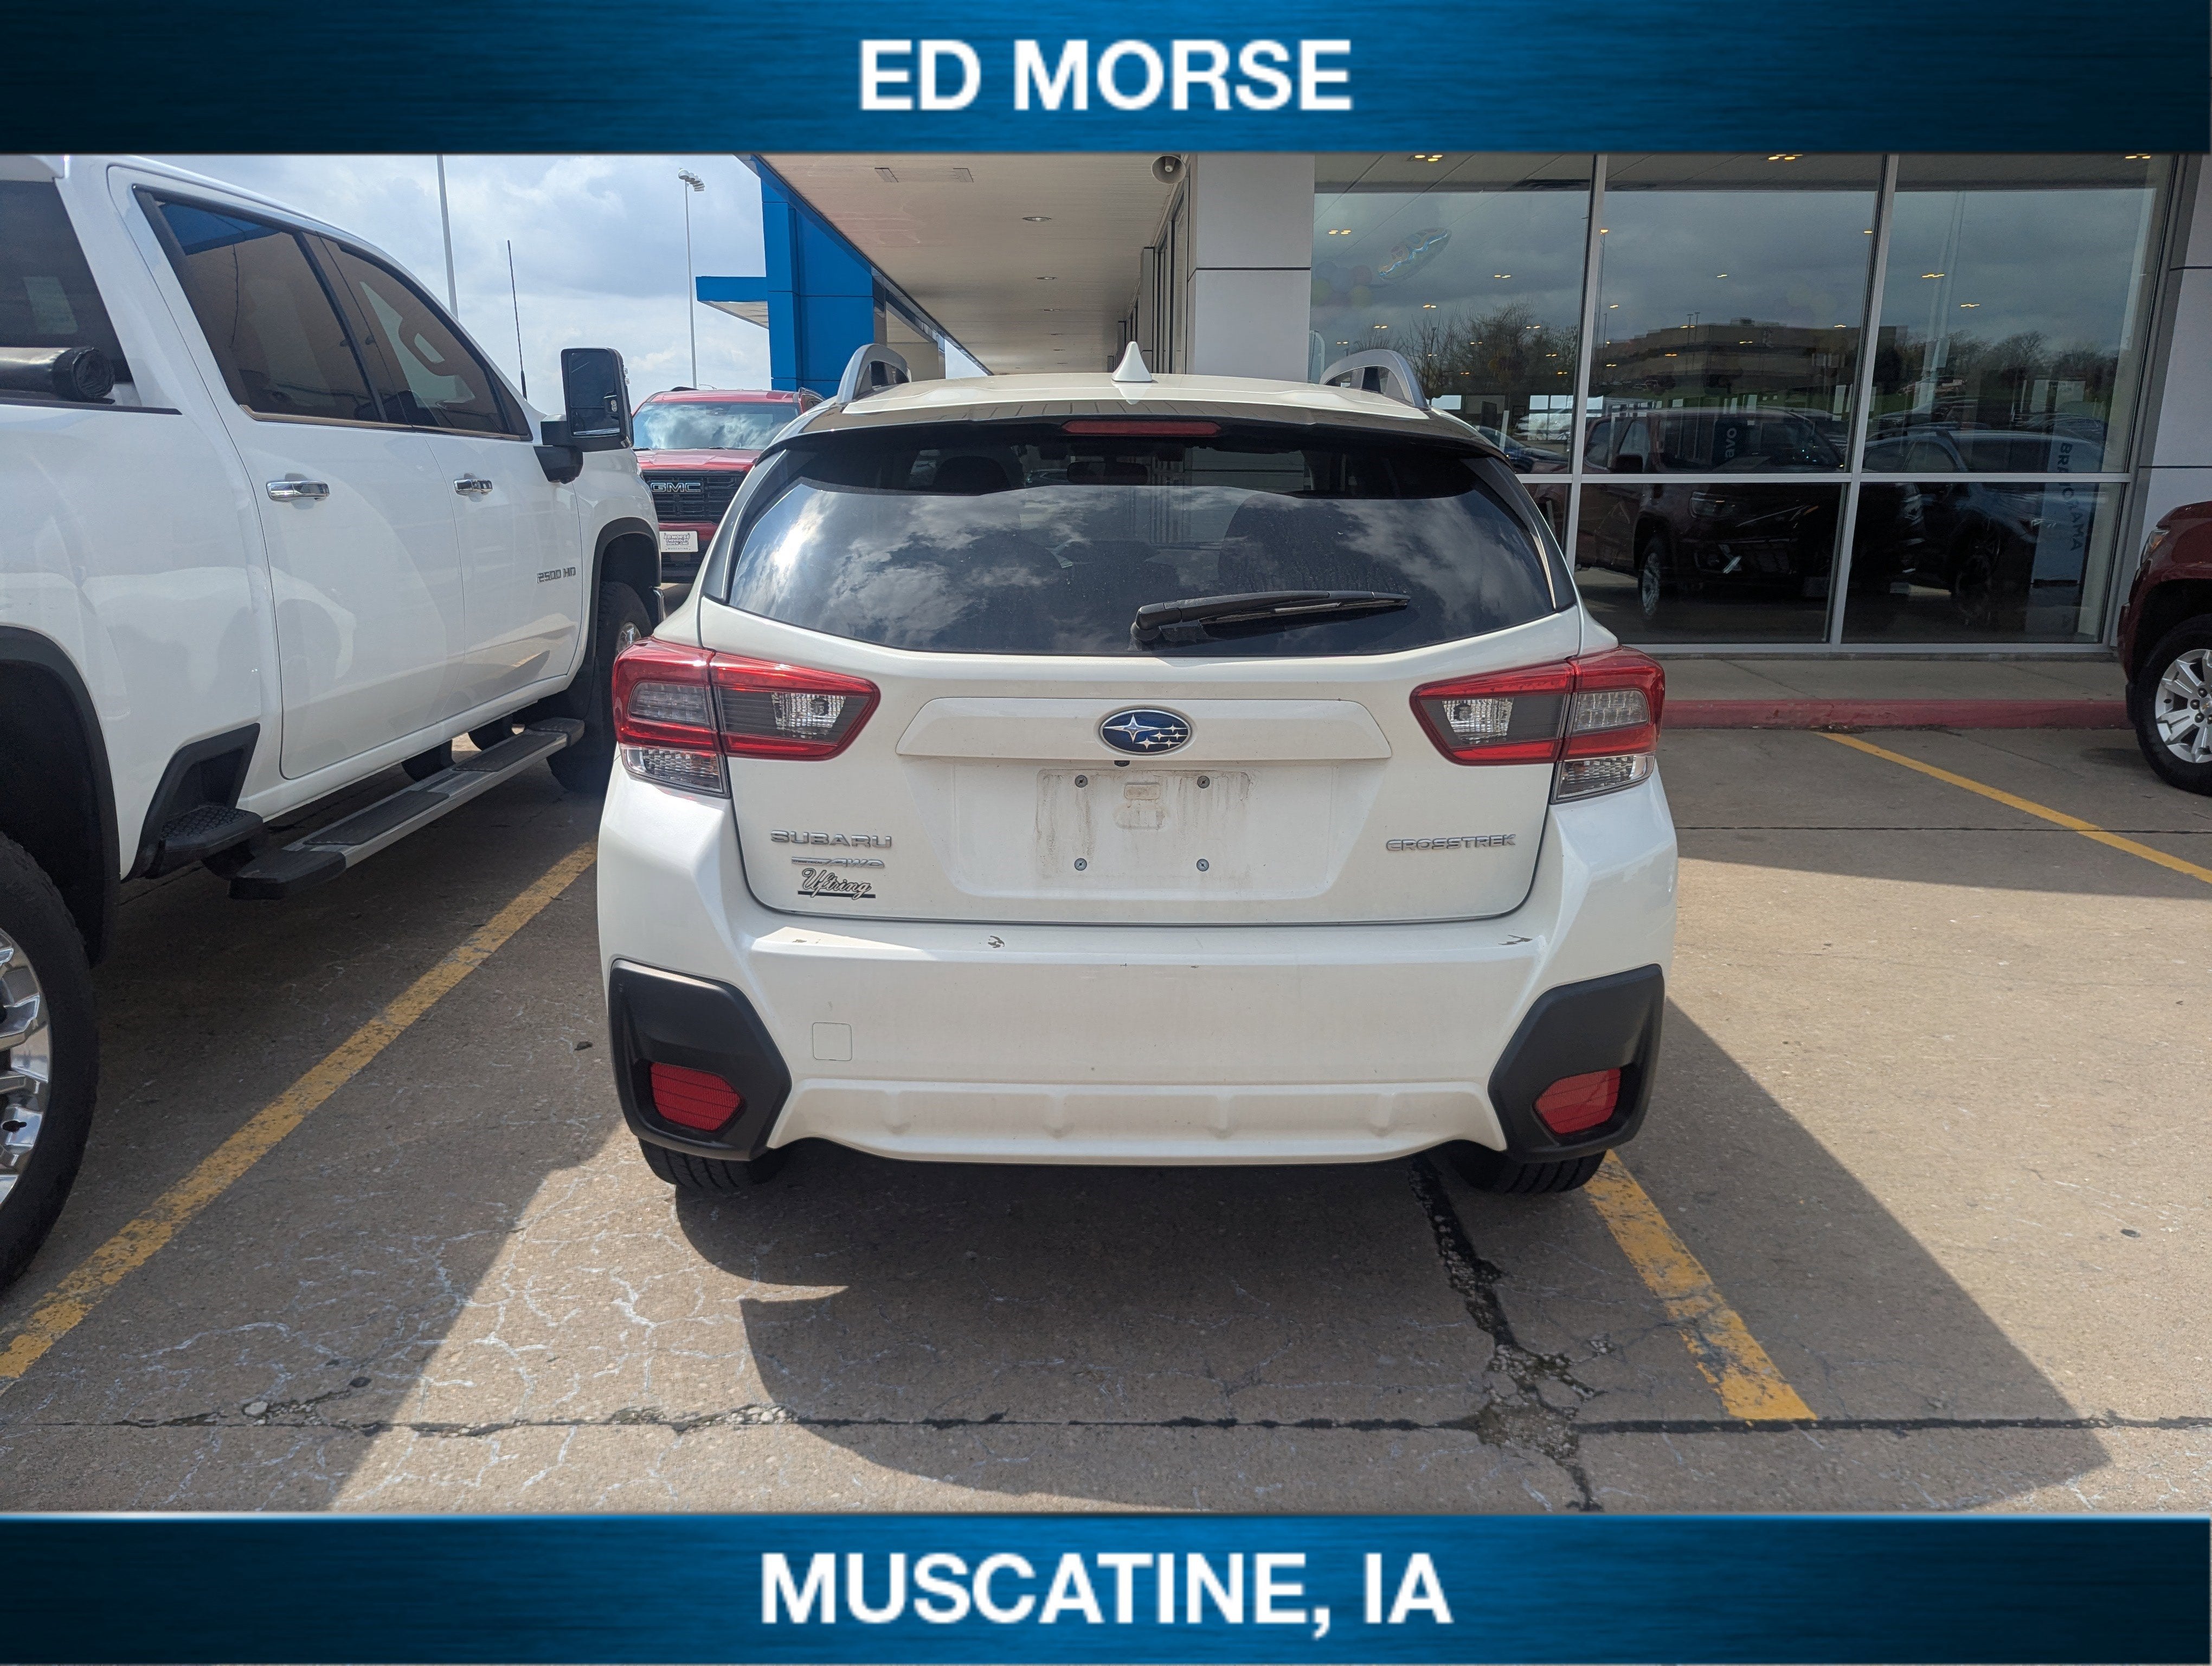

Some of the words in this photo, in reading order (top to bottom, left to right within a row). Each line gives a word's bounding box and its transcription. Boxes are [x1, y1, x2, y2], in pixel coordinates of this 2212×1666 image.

[650, 482, 701, 492] GMC
[537, 569, 562, 584] 2500
[563, 567, 576, 578] HD
[770, 830, 892, 848] SUBARU
[1386, 834, 1516, 851] CROSSTREK
[826, 858, 885, 869] AWD
